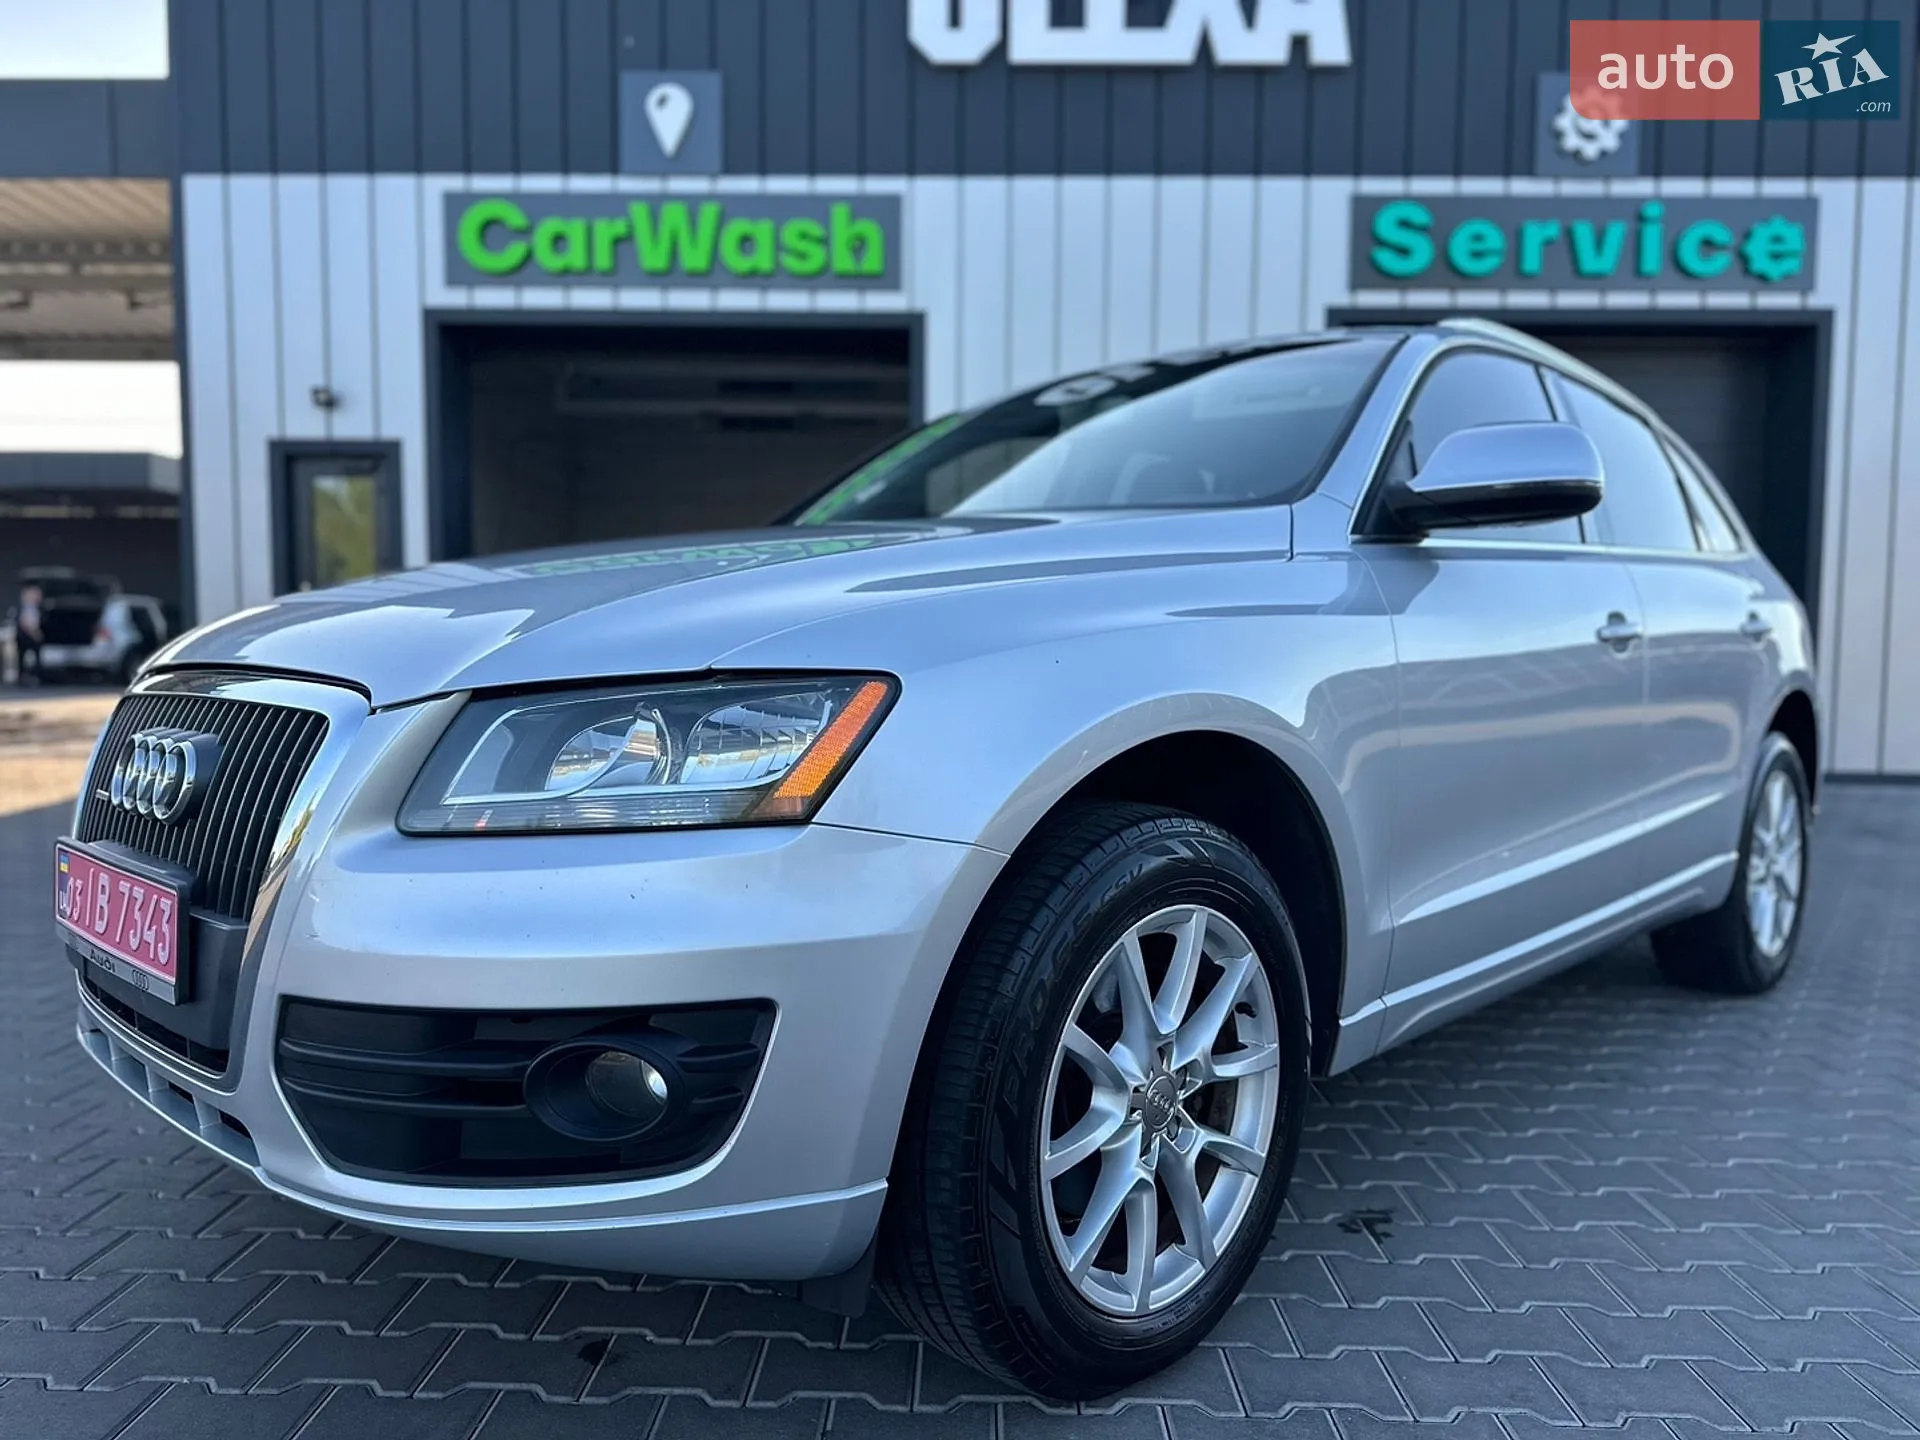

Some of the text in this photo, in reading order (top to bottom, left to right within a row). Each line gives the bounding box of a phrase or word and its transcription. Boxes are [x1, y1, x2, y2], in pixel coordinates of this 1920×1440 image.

[457, 197, 885, 275] CarWash
[1370, 199, 1806, 282] Service
[114, 880, 174, 965] 7343
